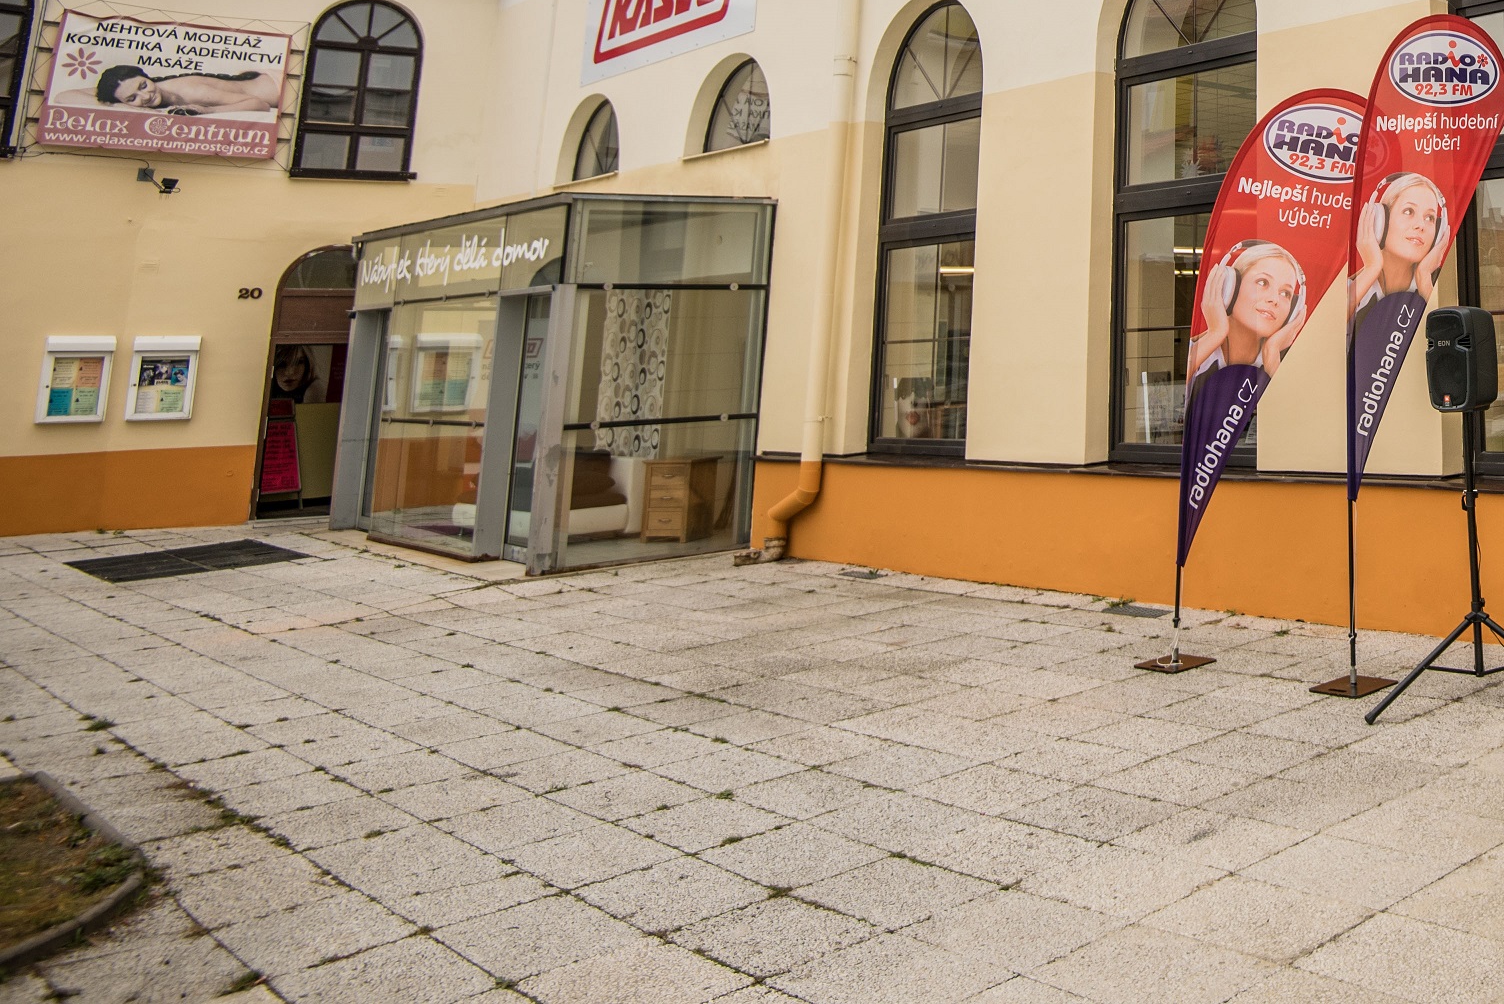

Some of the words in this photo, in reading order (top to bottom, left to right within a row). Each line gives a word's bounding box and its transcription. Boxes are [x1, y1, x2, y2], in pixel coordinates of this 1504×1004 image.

[96, 22, 178, 40] NEHTOVÁ
[183, 31, 263, 49] MODELÁŽ
[65, 33, 163, 53] KOSMETIKA
[176, 45, 283, 64] KADEŘNICTVÍ
[137, 55, 204, 71] MASÁŽE
[1398, 66, 1490, 86] HANA
[1414, 83, 1447, 97] 92,3
[1452, 84, 1473, 96] FM
[44, 107, 129, 134] Relax
[144, 115, 271, 145] Centrum
[1376, 112, 1438, 135] Nejlepší
[1440, 112, 1499, 129] hudební
[44, 131, 269, 155] www.relaxcentrumprostejov.cz
[1272, 132, 1358, 164] HAN
[1414, 133, 1461, 155] výběr!
[1288, 152, 1326, 171] 92,3
[1330, 160, 1355, 176] FM
[1237, 176, 1310, 203] Nejlepší
[1310, 187, 1352, 210] hude
[1278, 206, 1332, 229] výběr!
[361, 245, 412, 294] Nábytek
[415, 239, 450, 286] který
[453, 233, 488, 272] dělá
[491, 227, 550, 268] domov
[238, 287, 263, 300] 20
[1357, 304, 1415, 437] radiohana.cz
[1188, 378, 1259, 510] radiohana.cz
